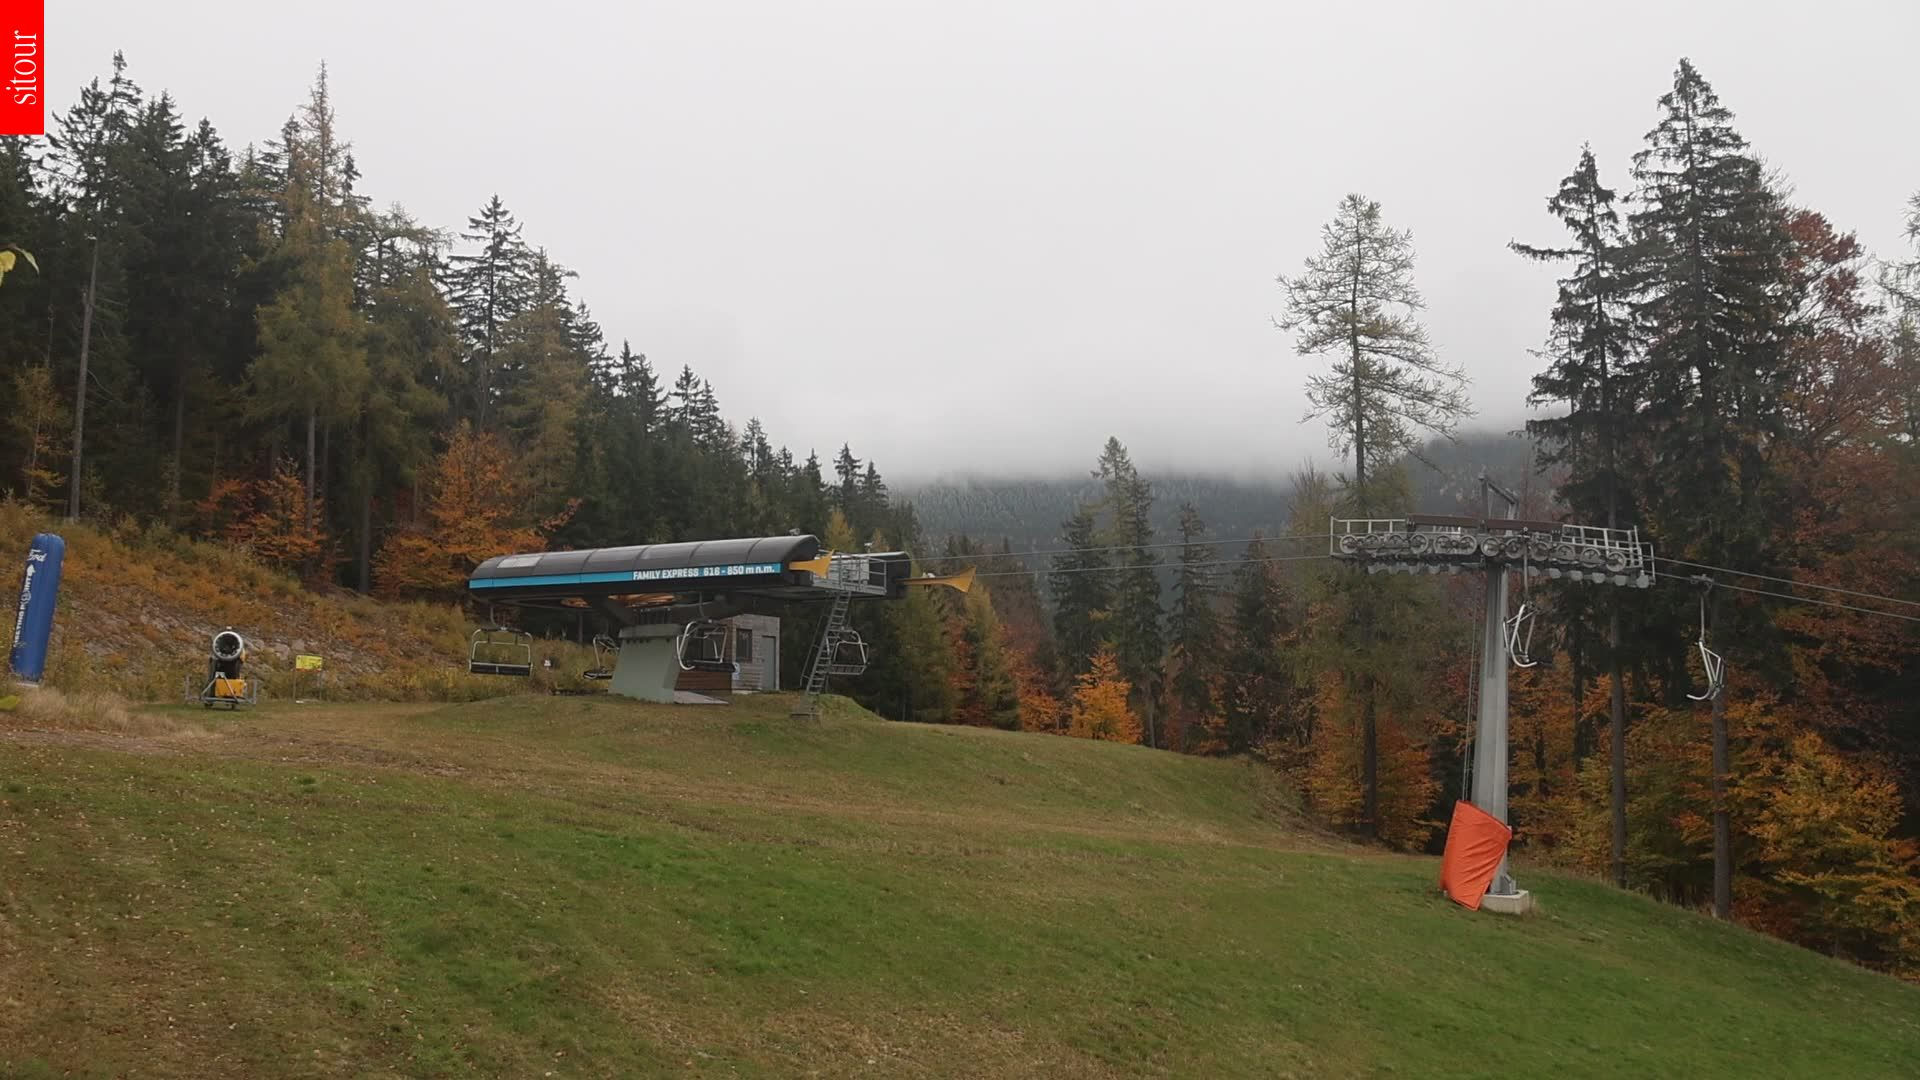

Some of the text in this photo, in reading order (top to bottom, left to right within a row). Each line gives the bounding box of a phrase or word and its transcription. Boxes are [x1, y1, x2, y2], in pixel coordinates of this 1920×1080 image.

[633, 570, 661, 581] FAMILY
[662, 568, 699, 580] EXPRESS
[727, 566, 745, 576] 850
[746, 567, 755, 575] m
